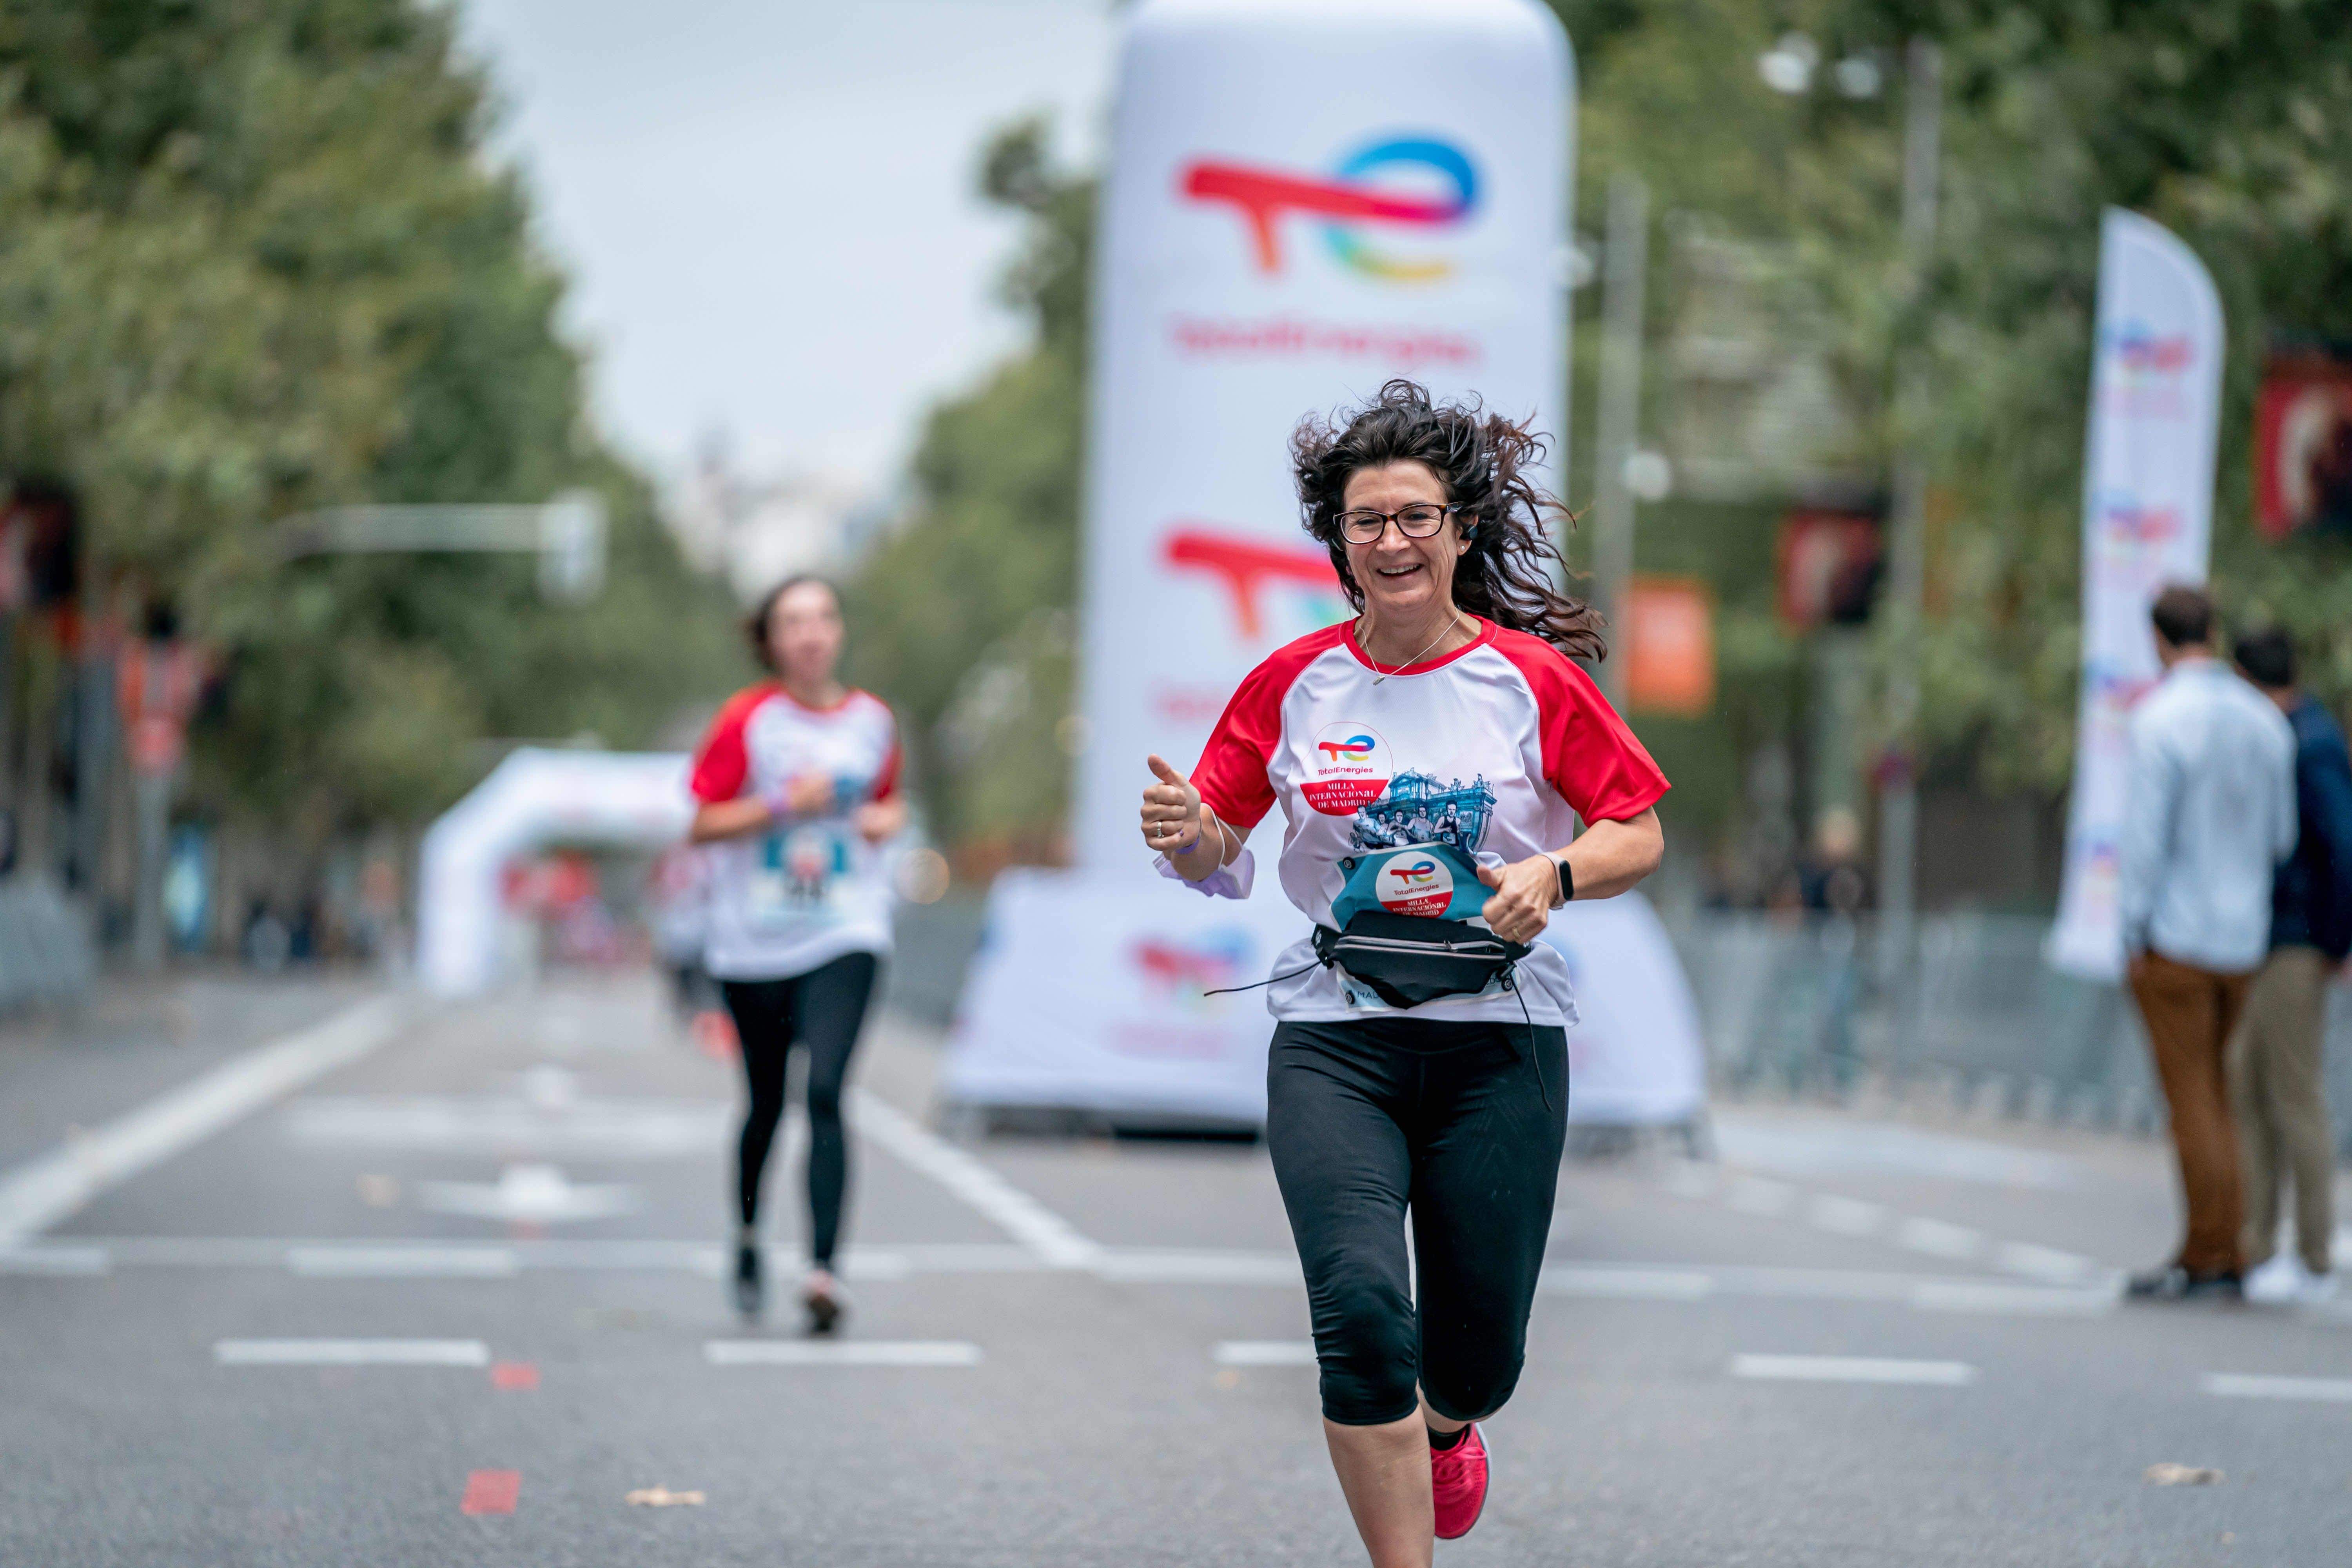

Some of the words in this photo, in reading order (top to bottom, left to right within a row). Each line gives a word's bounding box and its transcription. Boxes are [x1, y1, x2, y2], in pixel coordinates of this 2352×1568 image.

[1318, 766, 1373, 776] TotalEnergies
[1331, 799, 1366, 808] MADRID
[1394, 884, 1439, 895] TotalEnergies
